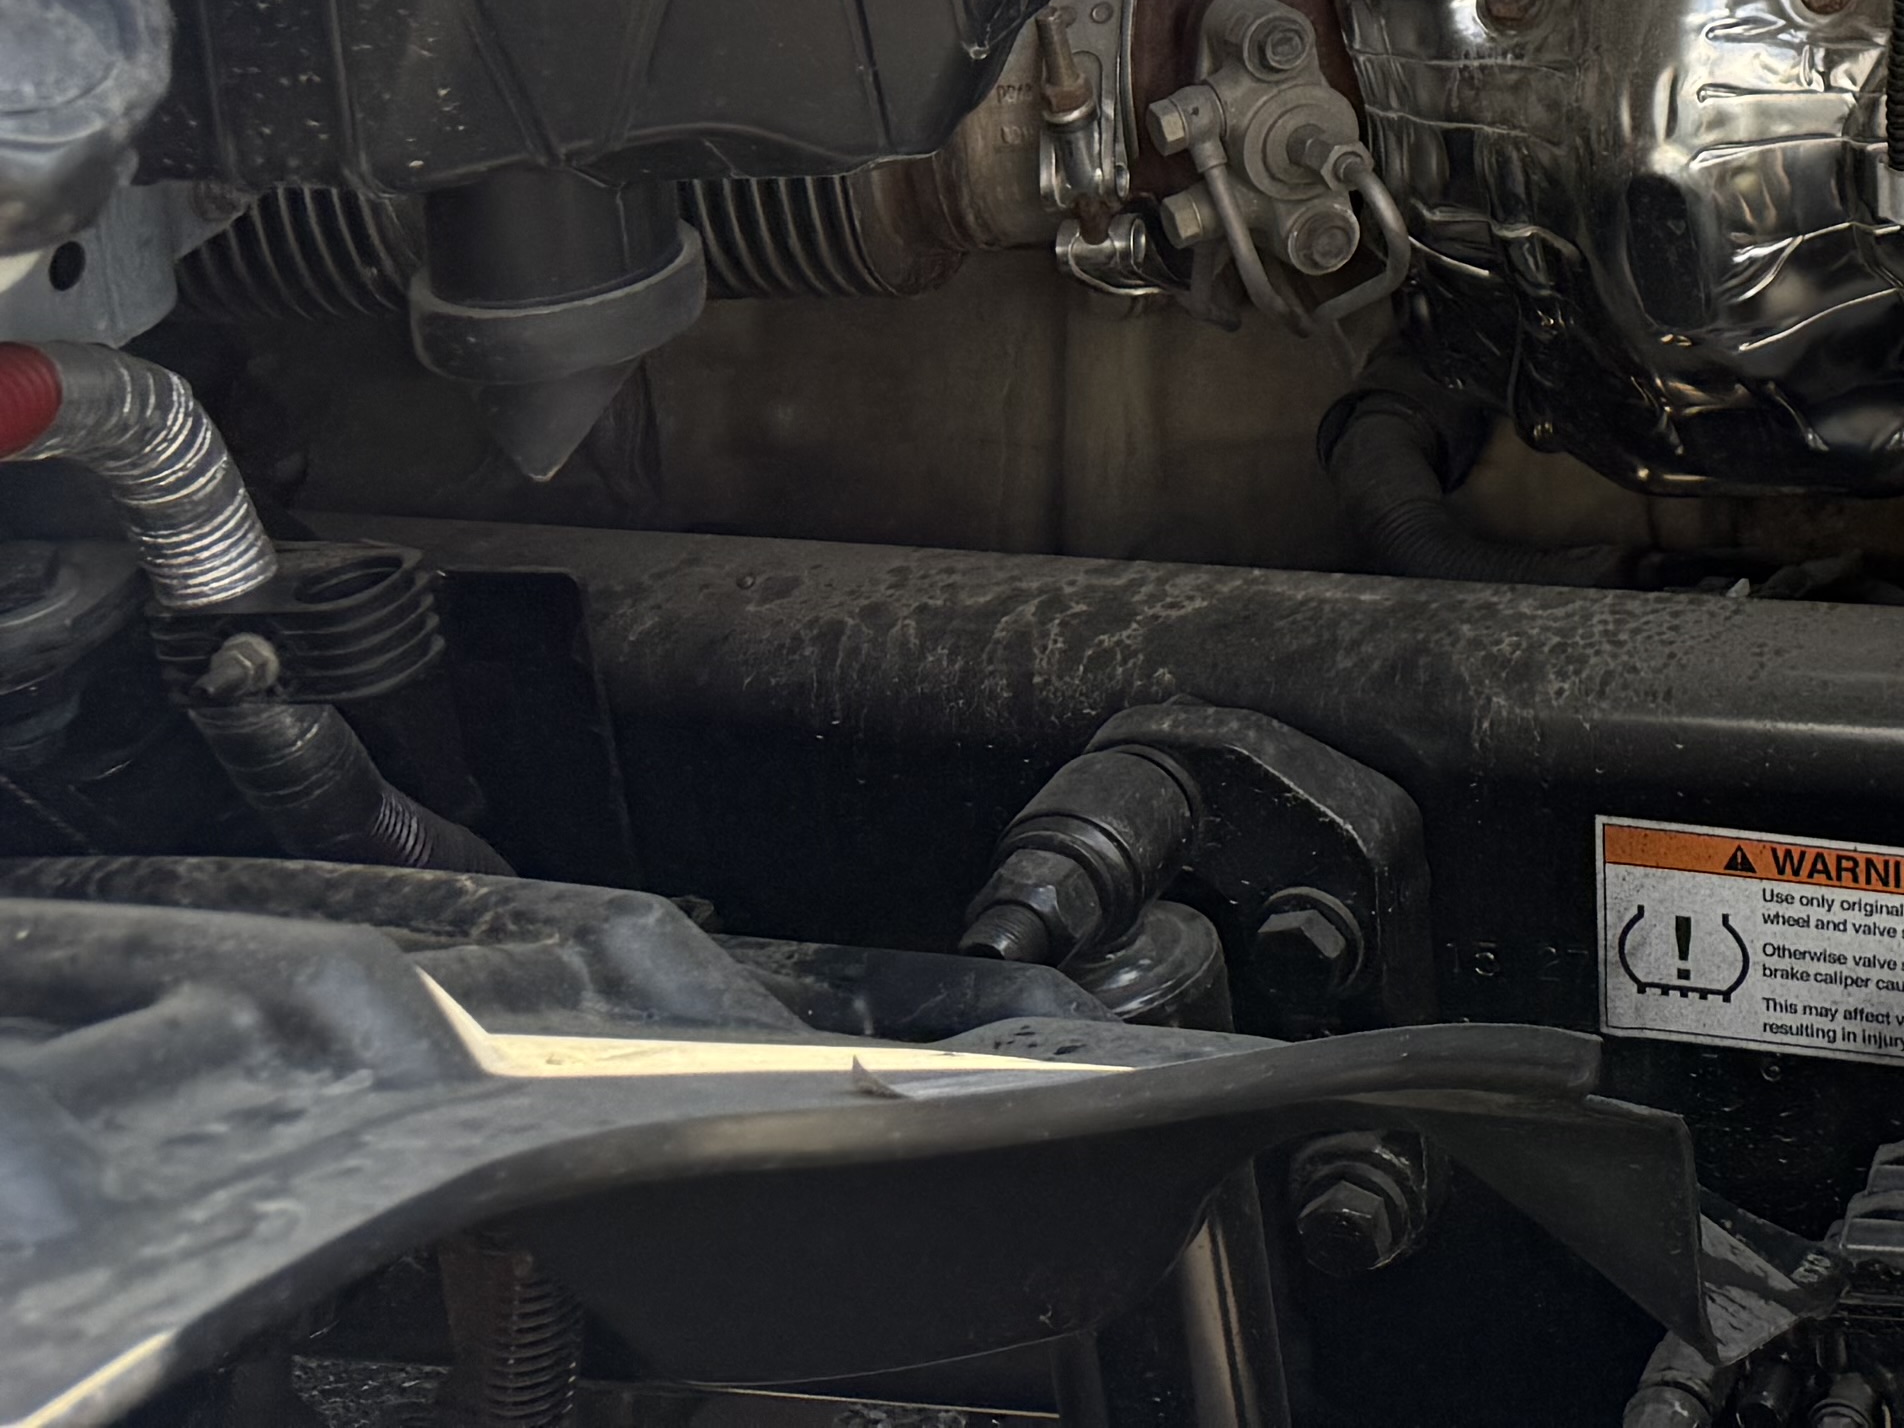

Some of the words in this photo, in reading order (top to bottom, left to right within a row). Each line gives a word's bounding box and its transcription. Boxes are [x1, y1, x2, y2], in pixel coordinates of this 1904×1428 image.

[1762, 887, 1795, 906] Use
[1799, 894, 1835, 913] only
[1840, 897, 1904, 918] original
[1762, 911, 1811, 929] wheel
[1814, 915, 1848, 933] and
[1852, 921, 1897, 939] valve
[1762, 941, 1849, 966] Otherwise
[1852, 953, 1898, 972] valve
[1762, 963, 1812, 983] brake
[1813, 968, 1873, 990] caliper
[1762, 996, 1799, 1016] This
[1801, 1004, 1838, 1024] may
[1842, 1006, 1892, 1026] affect
[1762, 1020, 1837, 1044] resulting
[1841, 1026, 1858, 1042] in
